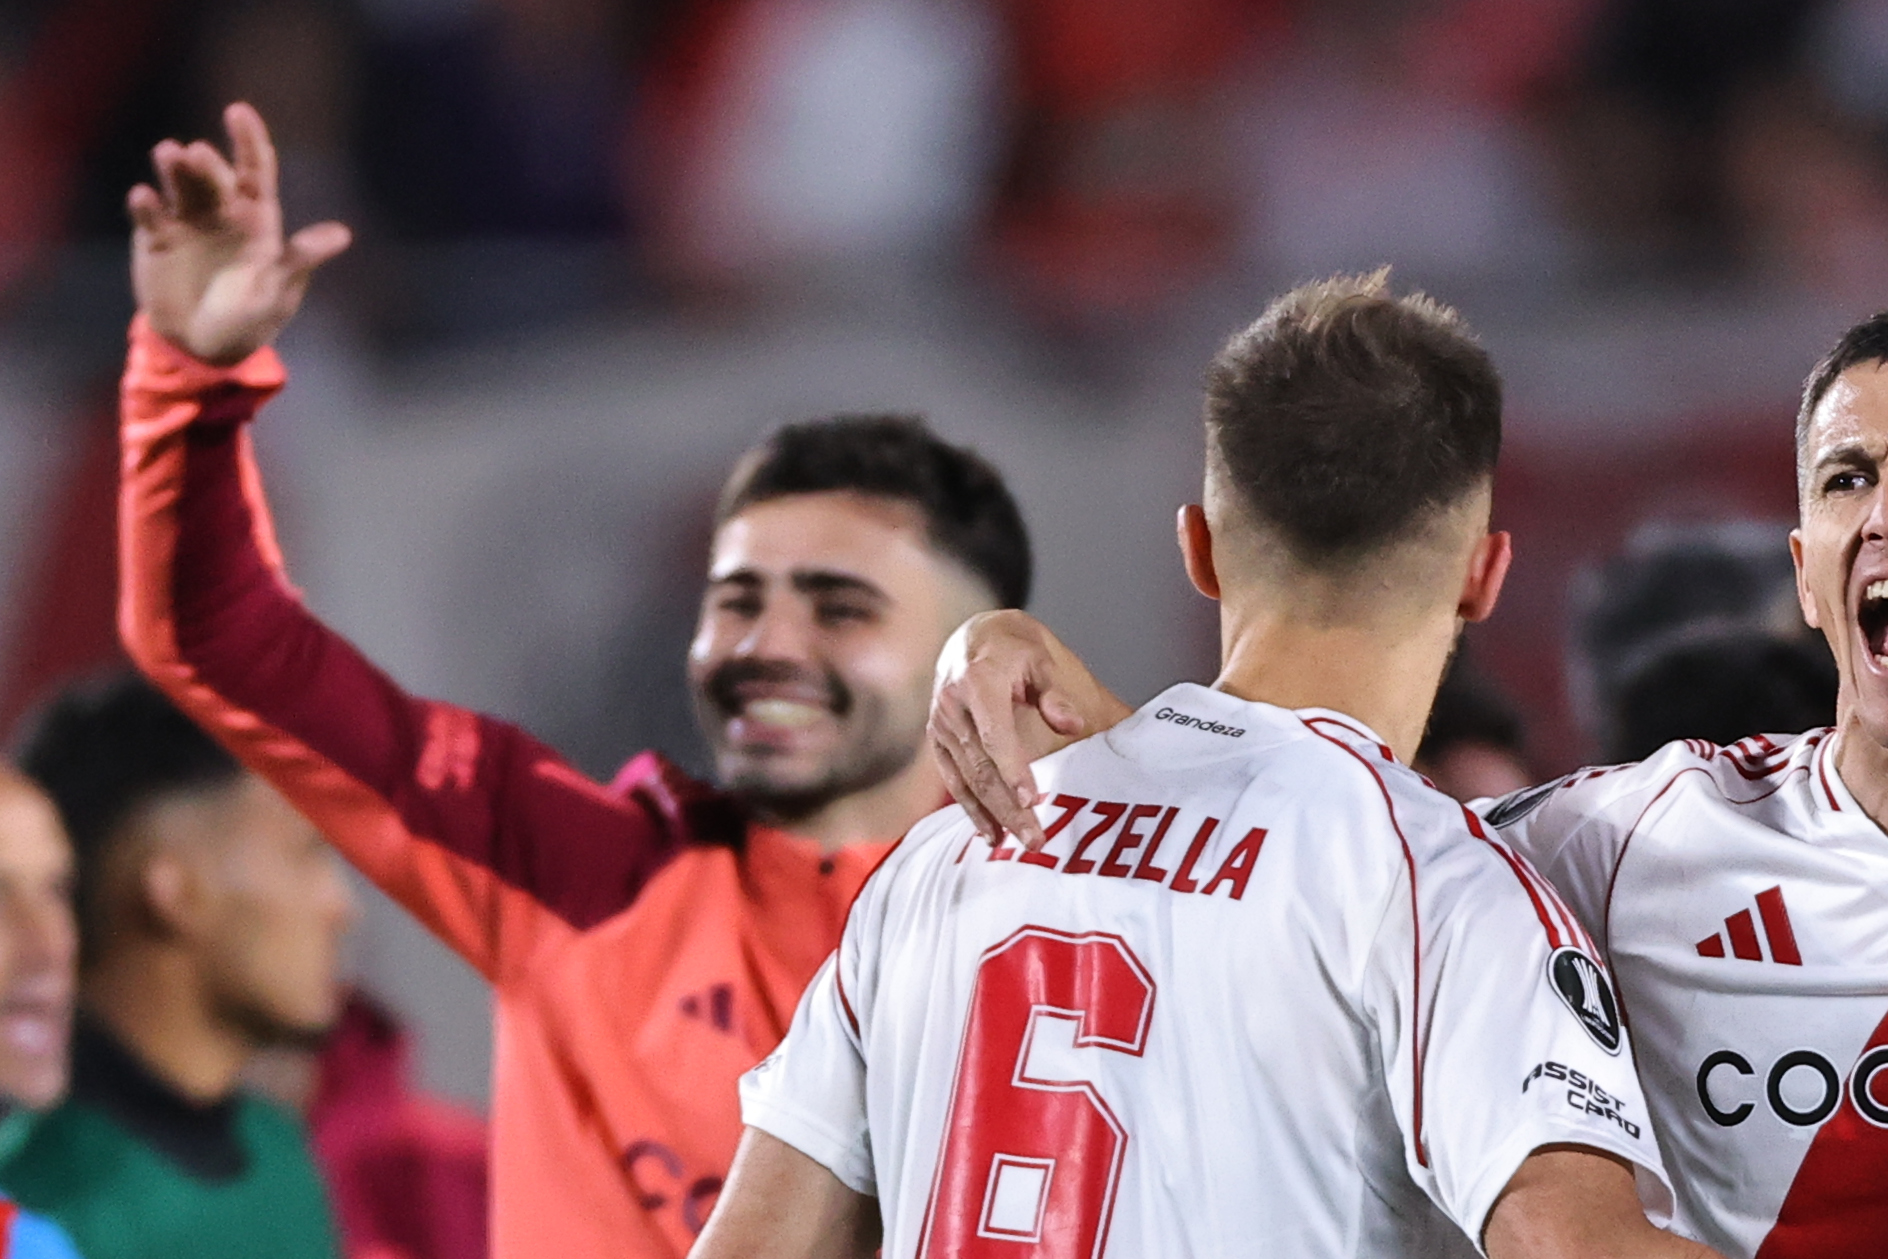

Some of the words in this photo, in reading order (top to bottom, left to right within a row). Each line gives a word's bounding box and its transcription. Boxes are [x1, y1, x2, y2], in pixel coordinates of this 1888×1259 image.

[1154, 706, 1246, 738] Grandeza
[953, 792, 1269, 901] ZZELLA
[1522, 1060, 1626, 1111] ASSIST
[1566, 1089, 1641, 1140] CARD
